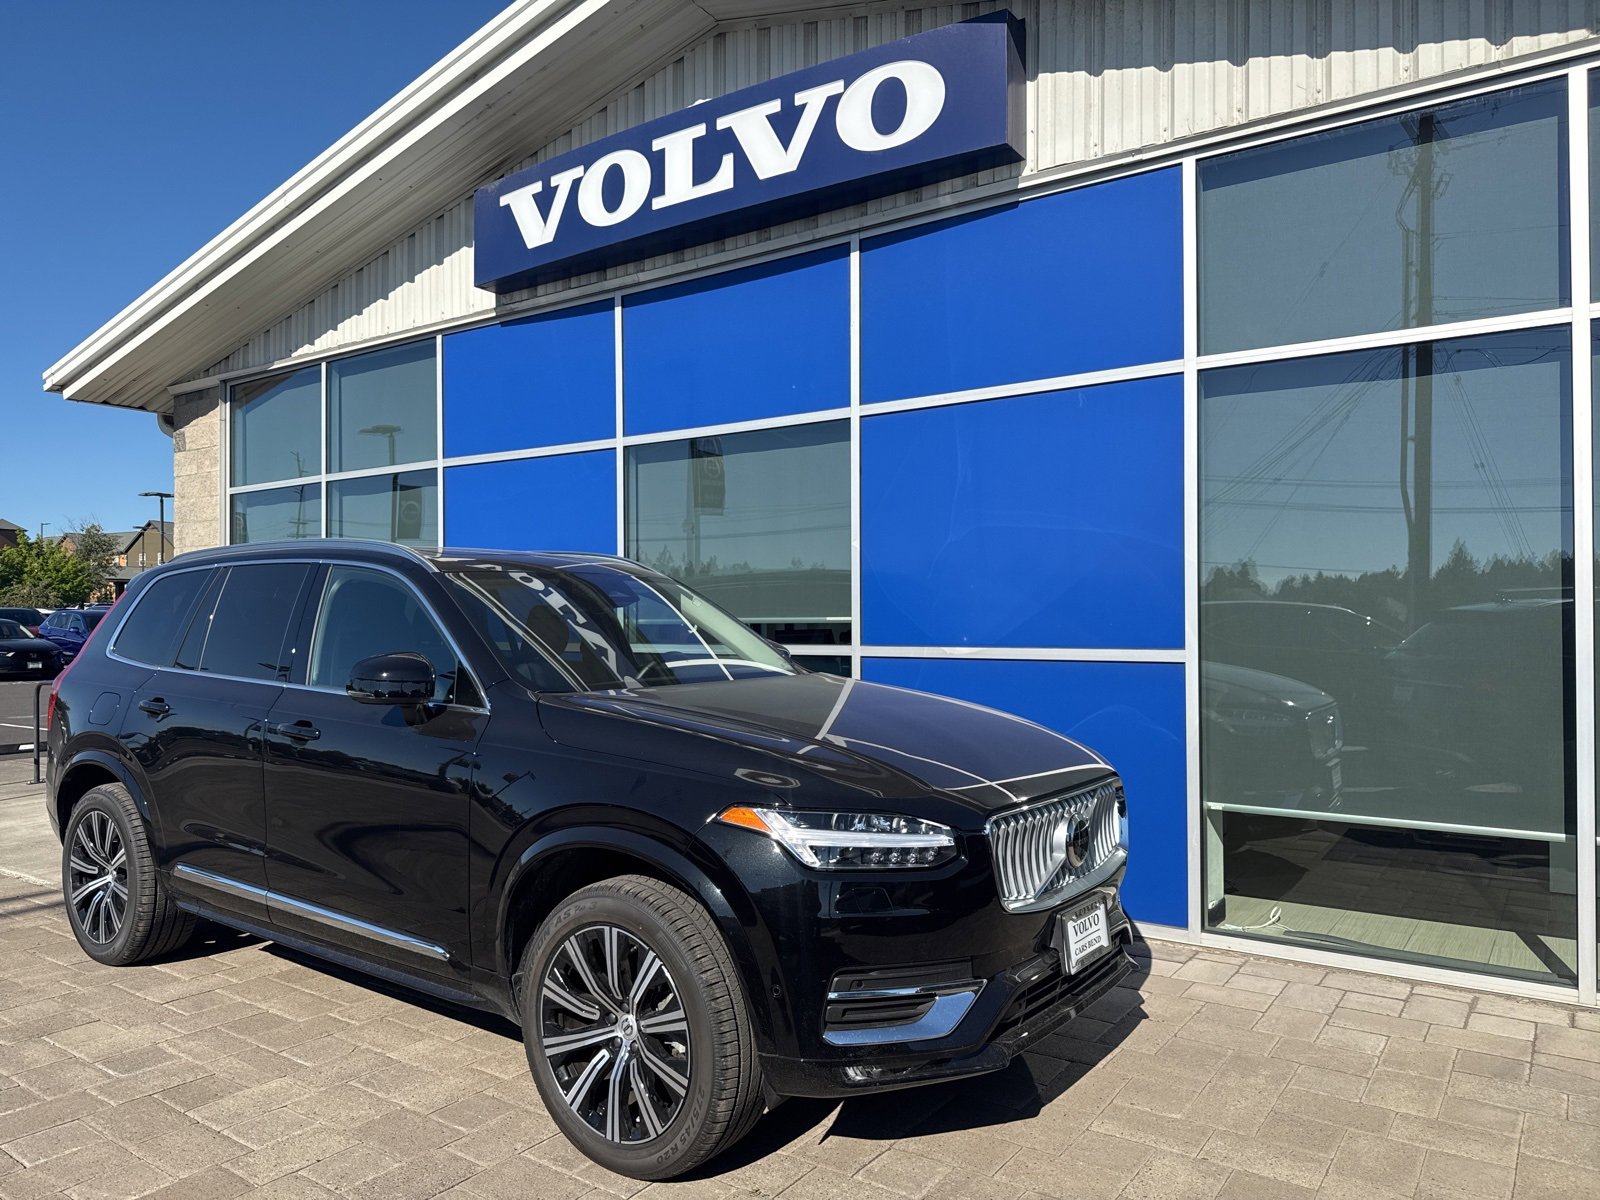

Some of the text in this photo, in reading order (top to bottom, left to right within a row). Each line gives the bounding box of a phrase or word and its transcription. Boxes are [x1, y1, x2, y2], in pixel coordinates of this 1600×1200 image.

[500, 60, 945, 249] VOLVO
[1073, 913, 1099, 937] VOLVO
[1074, 935, 1101, 956] CARS BEND
[656, 1143, 679, 1164] R20
